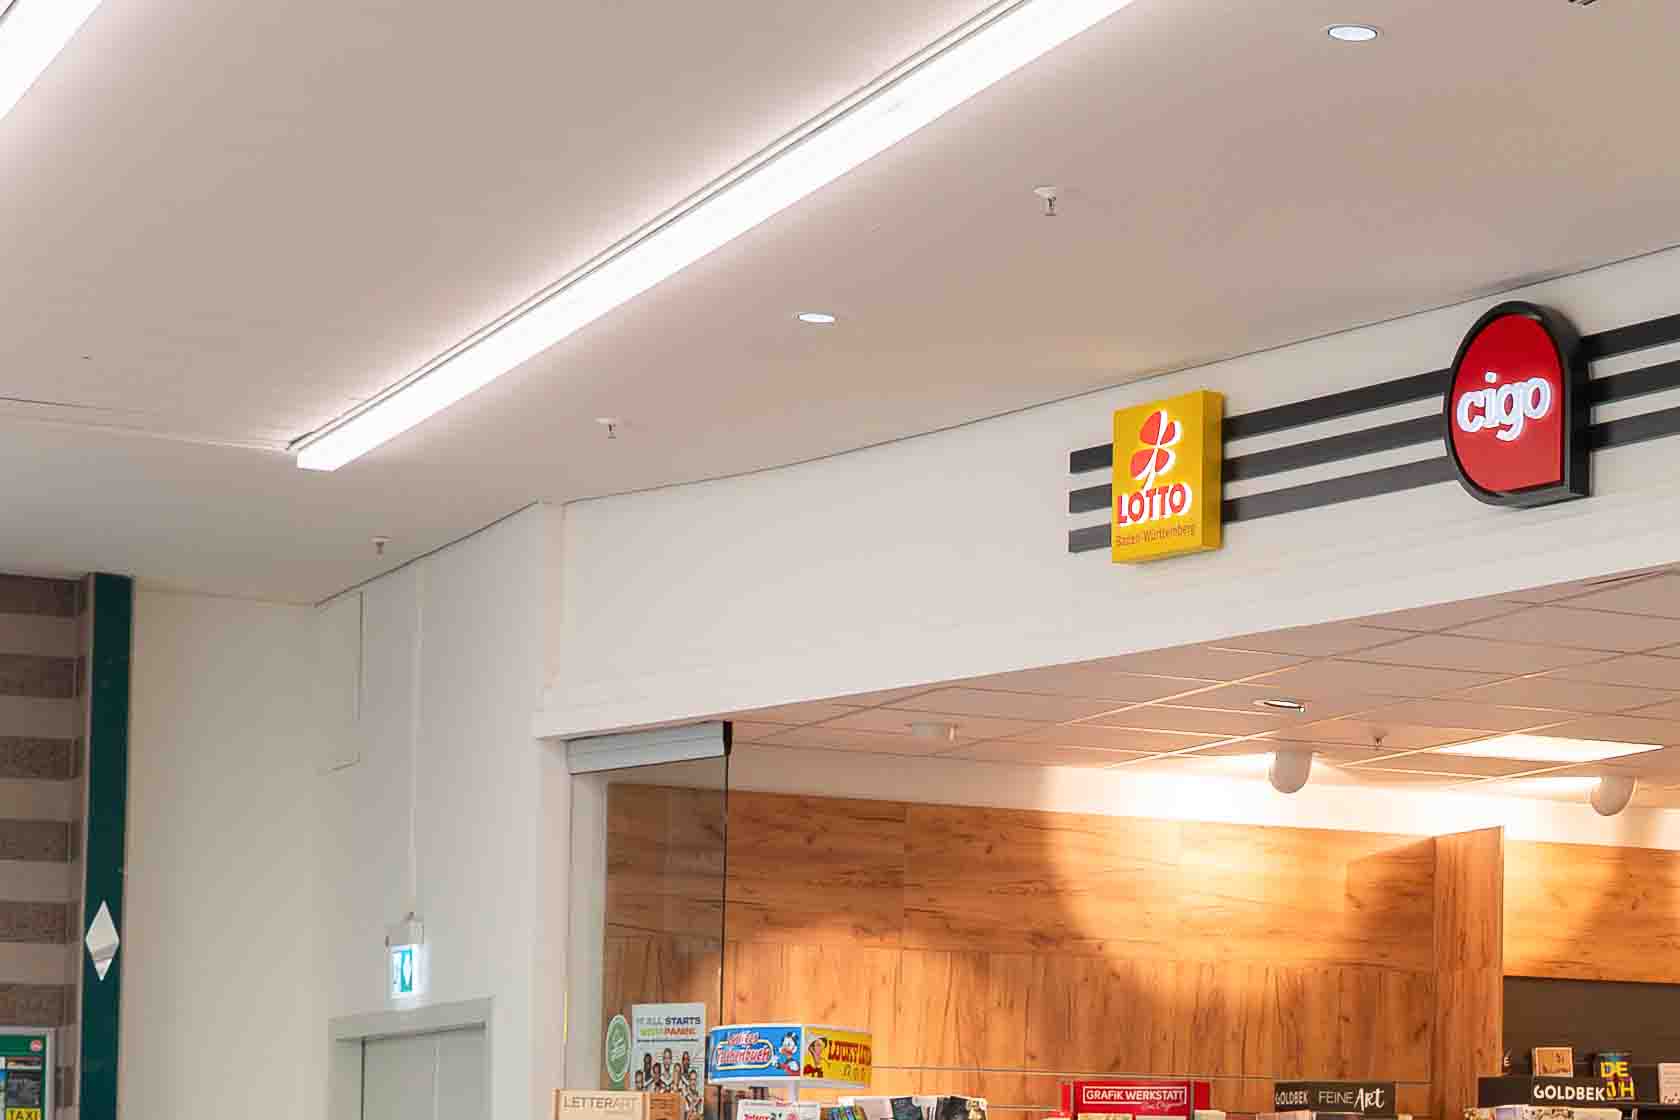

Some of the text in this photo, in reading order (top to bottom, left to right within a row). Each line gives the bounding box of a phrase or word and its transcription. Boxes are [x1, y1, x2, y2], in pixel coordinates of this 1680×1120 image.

[1456, 371, 1551, 441] cigo
[1117, 482, 1190, 526] LOTTO
[664, 1016, 701, 1025] STARTS
[1601, 1061, 1630, 1078] DE
[1126, 1088, 1184, 1101] WERKSTATT
[1275, 1090, 1308, 1105] GOLDBEK
[1318, 1091, 1353, 1104] FEINE
[1533, 1084, 1605, 1101] GOLDBEK
[8, 1110, 40, 1120] TAXI
